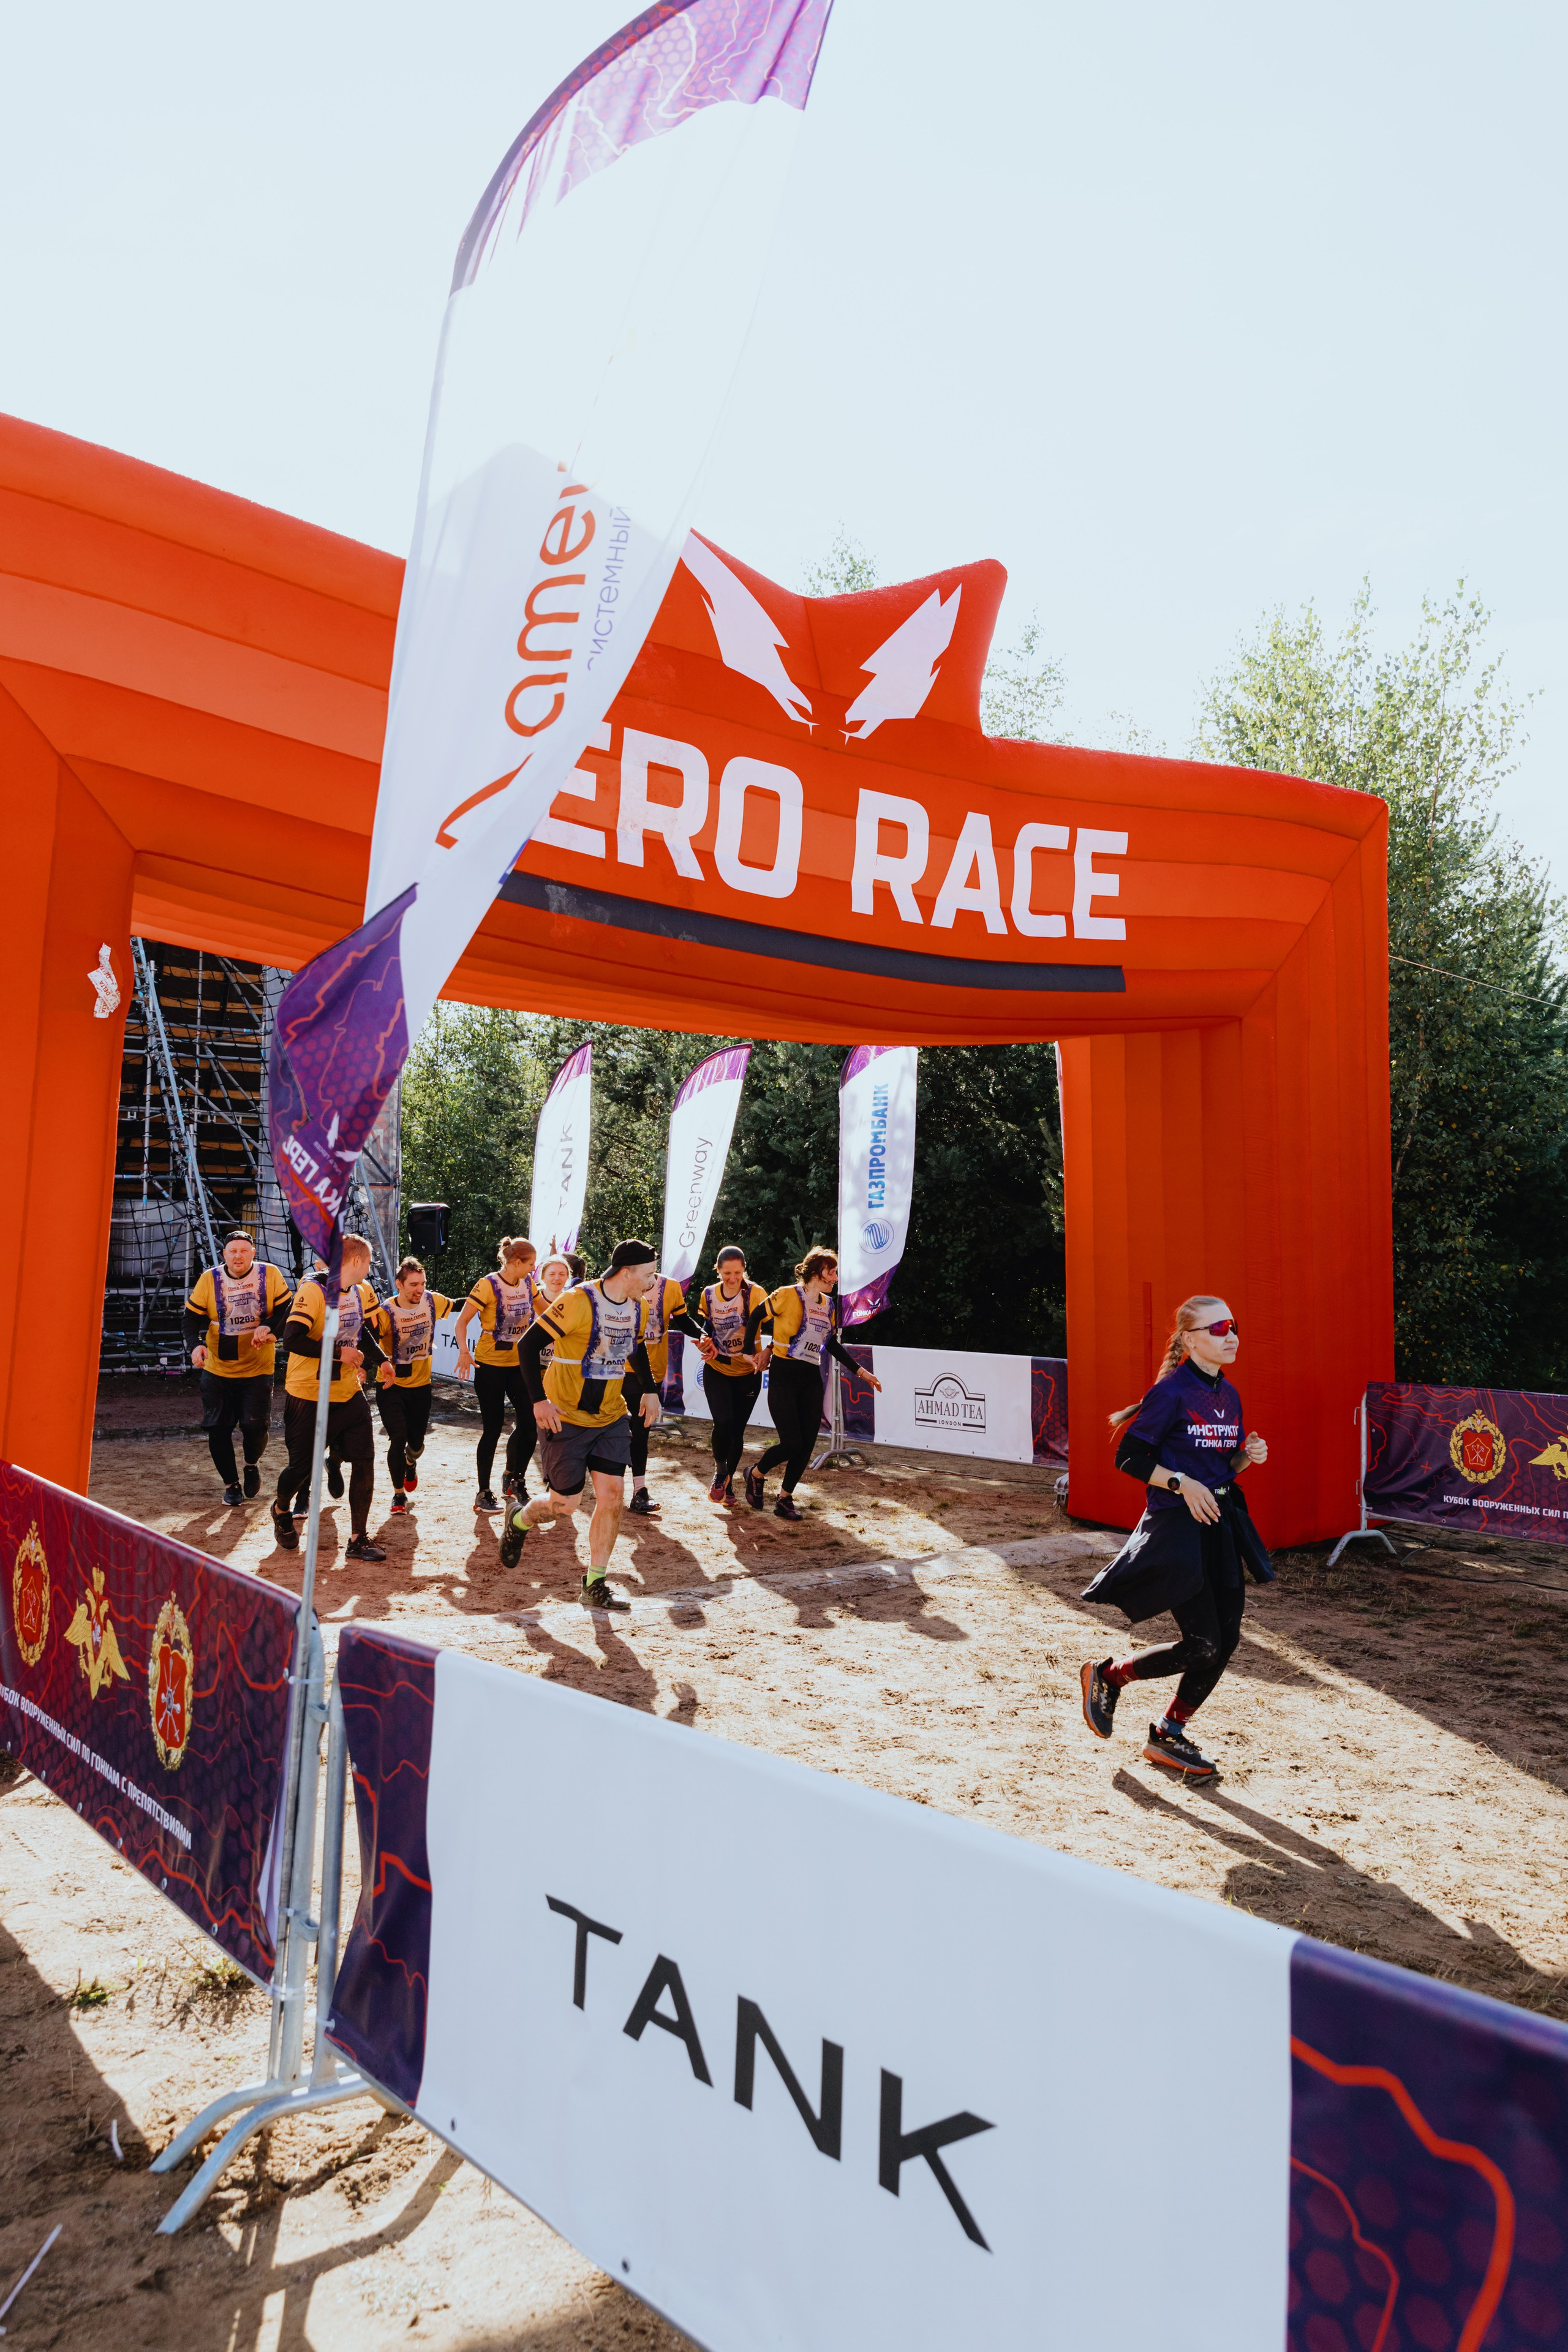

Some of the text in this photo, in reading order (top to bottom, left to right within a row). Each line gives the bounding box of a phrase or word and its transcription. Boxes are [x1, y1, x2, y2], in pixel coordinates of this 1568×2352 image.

[530, 719, 1129, 941] ERO RACE
[99, 981, 111, 996] DELTA
[868, 1083, 889, 1208] ГАЗПРОМБАНК
[679, 1137, 713, 1248] Greenway
[804, 1341, 821, 1354] 1020
[918, 1400, 983, 1420] AHMAD TEA
[1195, 1438, 1237, 1448] ГОНКА ГЕРО
[1443, 1495, 1470, 1506] КУБОК
[1472, 1499, 1540, 1515] ВООРУЖЕННЫХ
[1542, 1508, 1560, 1518] СИЛ
[0, 1683, 192, 1850] УБОК ВООРУЖЕННЫХ СИЛ ПО ГОНКАМ С ПРЕПЯТСТВИЯМИ
[545, 1893, 998, 2256] TANK
